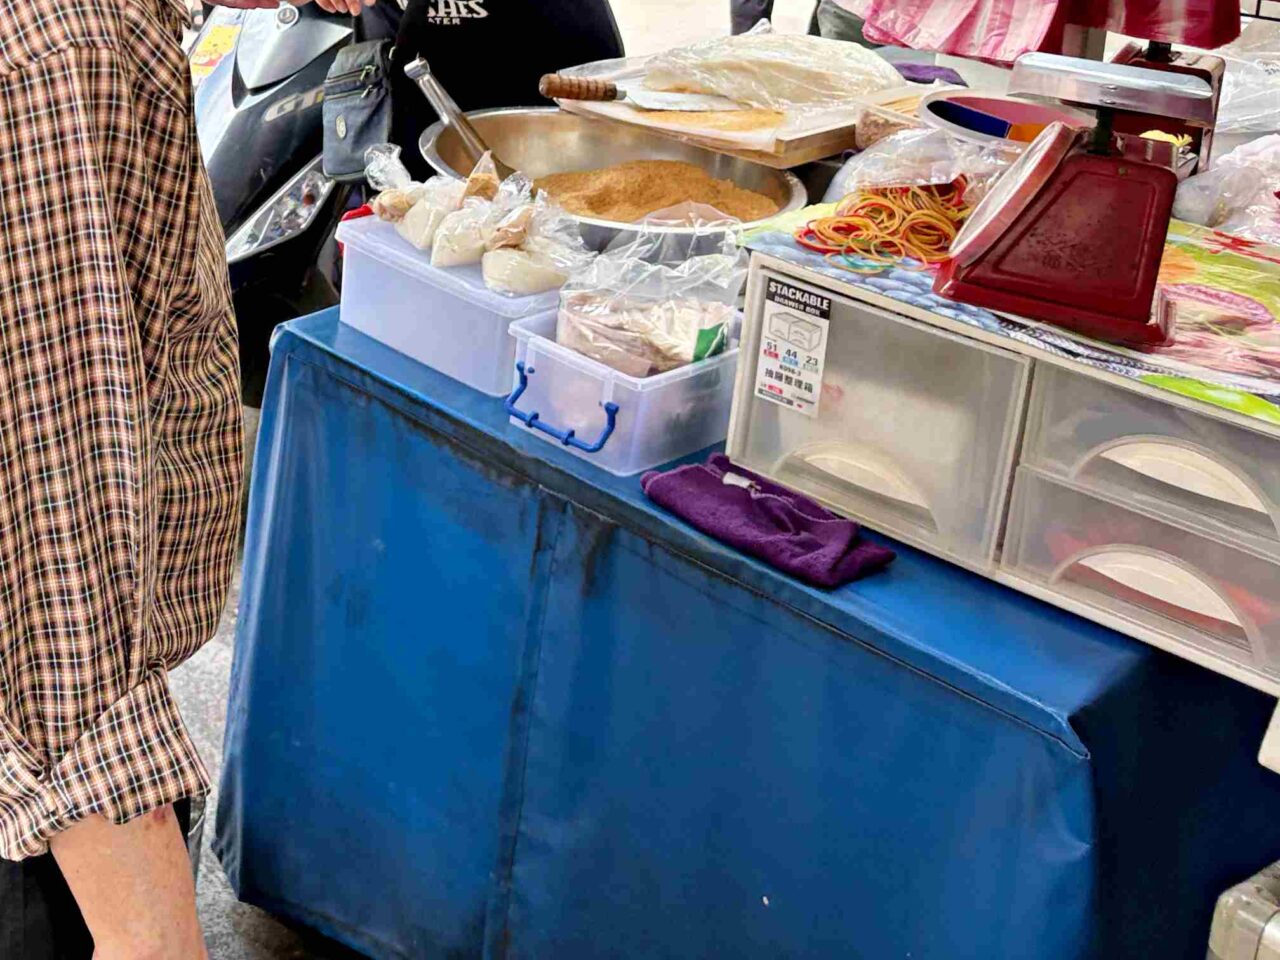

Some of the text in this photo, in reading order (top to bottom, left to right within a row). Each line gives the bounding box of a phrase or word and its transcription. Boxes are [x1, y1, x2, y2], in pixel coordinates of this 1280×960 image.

[768, 281, 830, 311] STACKABLE
[766, 341, 778, 352] 51
[785, 349, 798, 360] 44
[806, 355, 819, 366] 23
